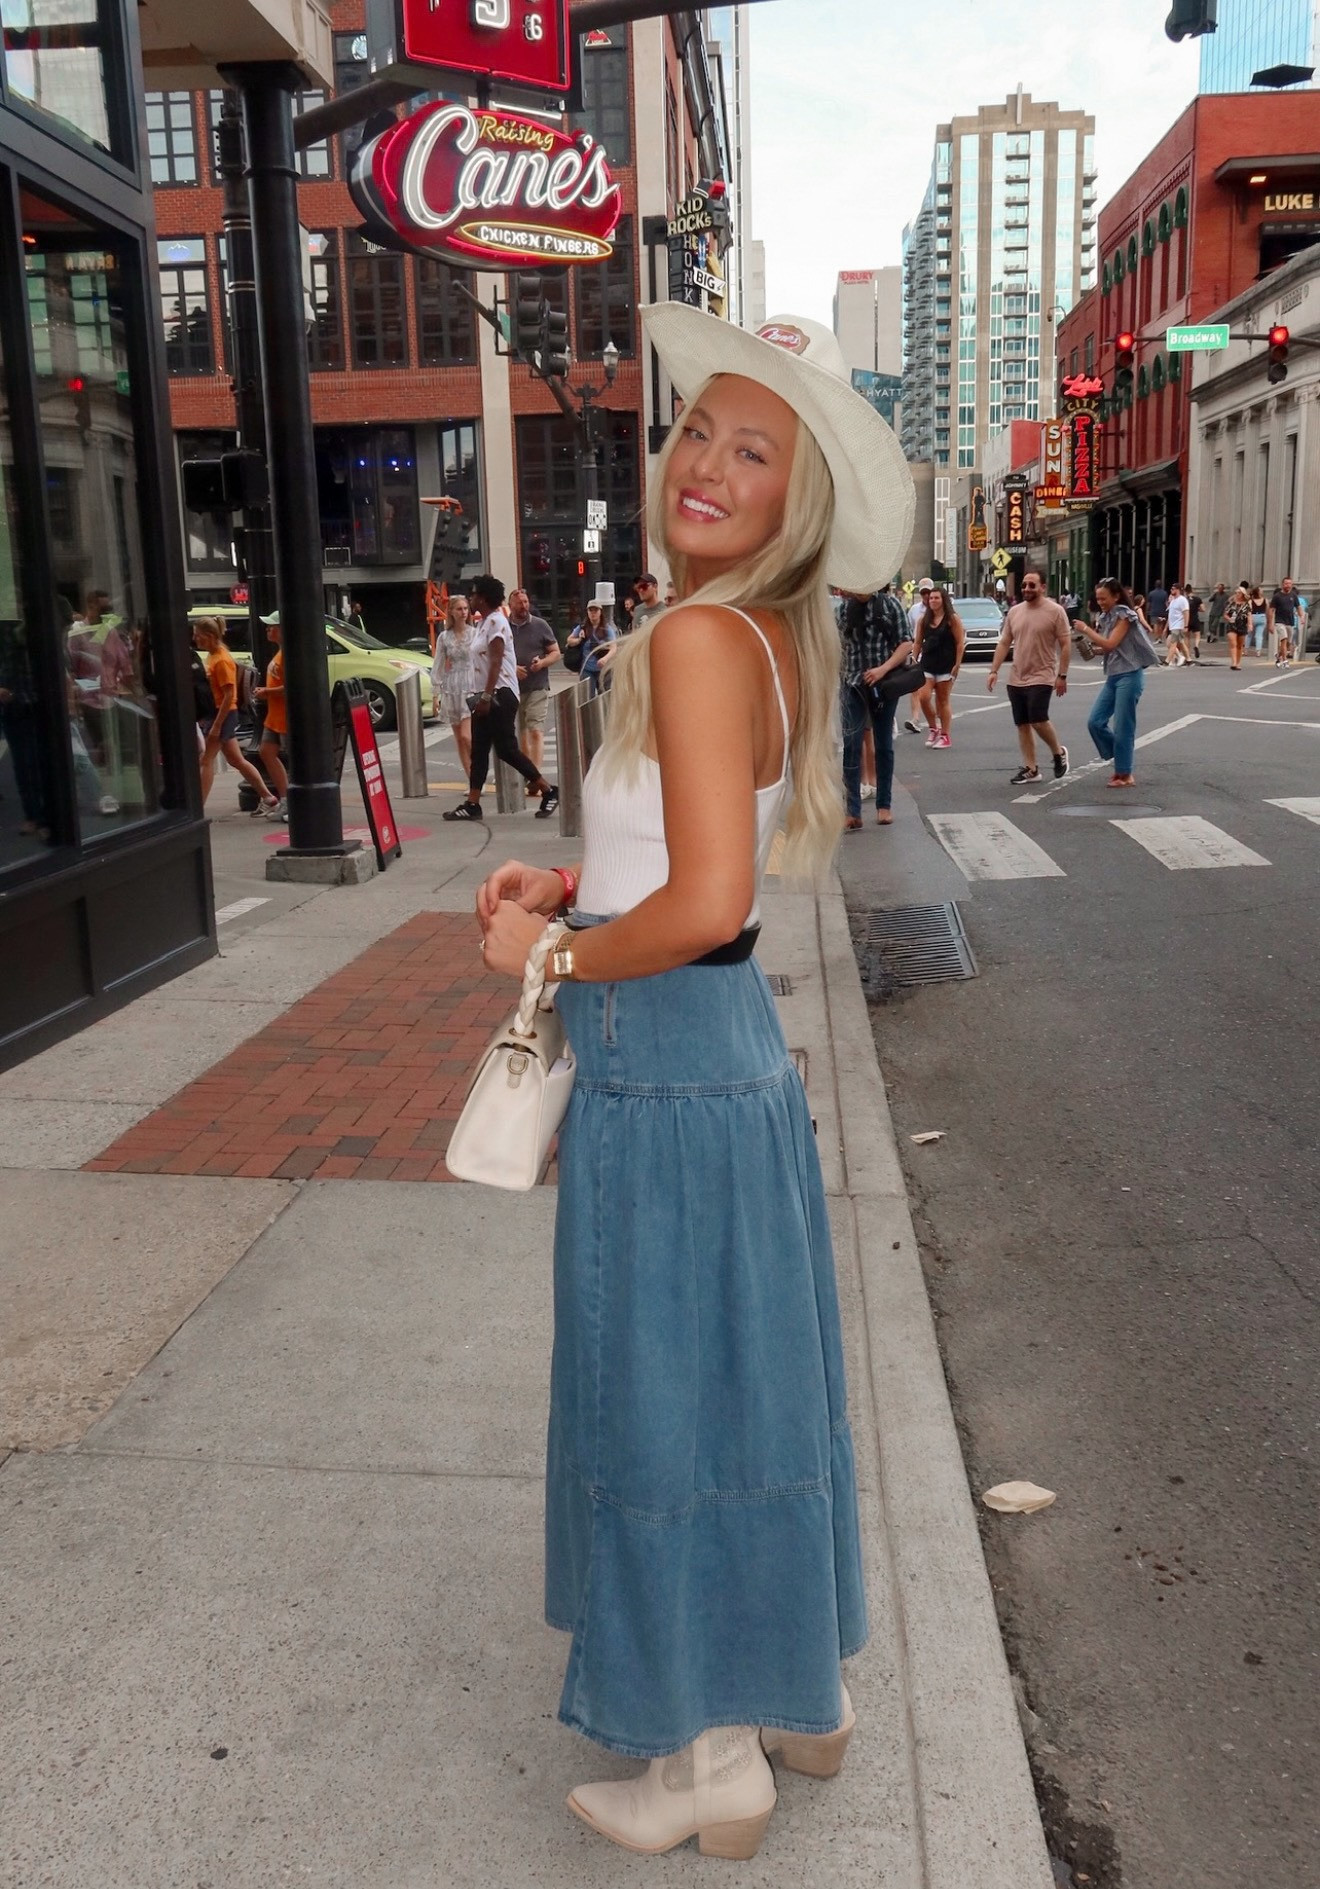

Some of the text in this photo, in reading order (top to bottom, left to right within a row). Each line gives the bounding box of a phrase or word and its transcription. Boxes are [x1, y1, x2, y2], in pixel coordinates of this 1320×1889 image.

[479, 116, 555, 152] Raising
[403, 104, 621, 229] Cane's
[676, 197, 703, 217] KID
[1264, 194, 1314, 211] LUKE
[480, 226, 599, 255] CHICKEN FINGERS
[696, 271, 715, 290] BIG
[841, 271, 874, 281] DRURY
[1169, 331, 1223, 345] Broadway
[866, 388, 903, 397] HYATT
[1066, 398, 1099, 412] CITY
[1047, 425, 1061, 473] SUN
[1073, 416, 1091, 493] PIZZA
[1010, 491, 1022, 541] CASH
